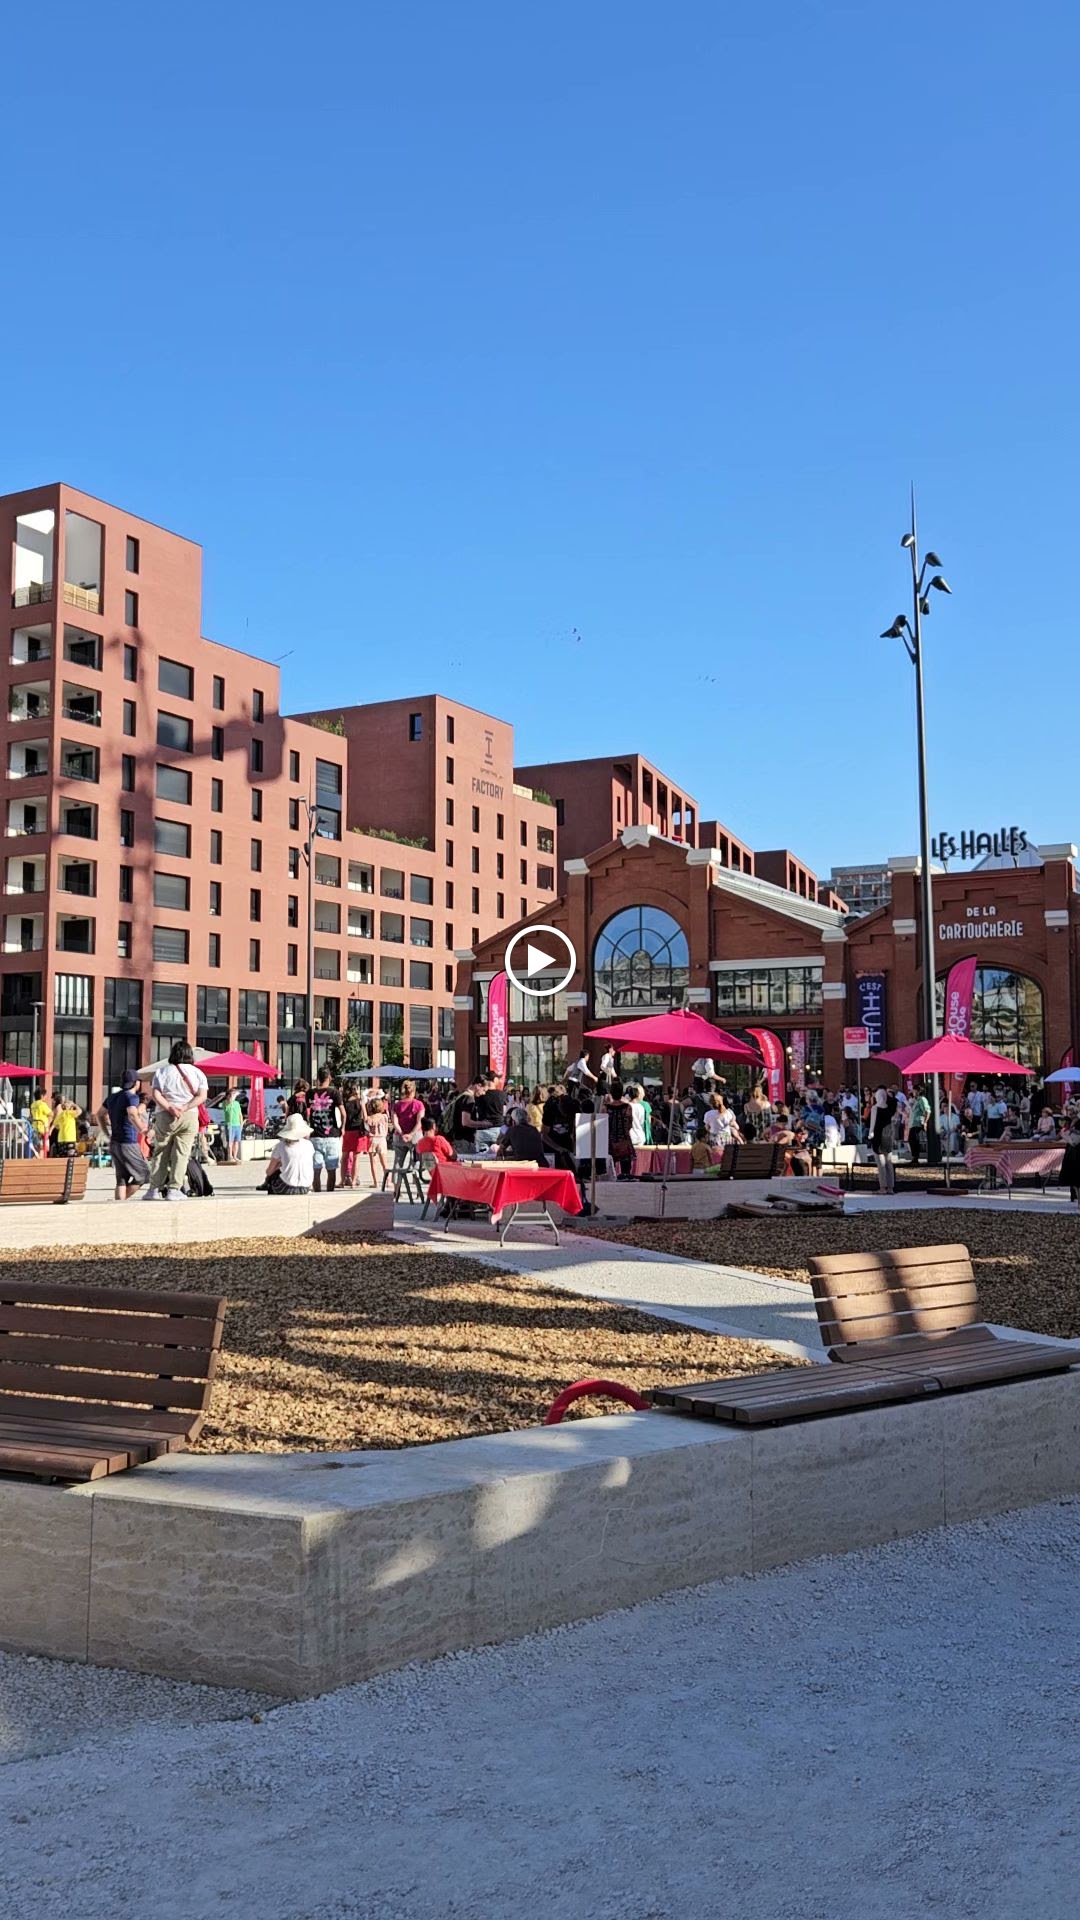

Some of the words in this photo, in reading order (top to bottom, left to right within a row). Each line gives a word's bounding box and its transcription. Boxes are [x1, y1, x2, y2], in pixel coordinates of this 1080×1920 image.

[472, 778, 504, 800] FACTORY
[931, 832, 955, 861] LES
[960, 826, 1028, 860] HALLES
[966, 907, 980, 917] DE
[982, 906, 996, 916] LA
[939, 920, 1023, 940] CARTOUCHERIE
